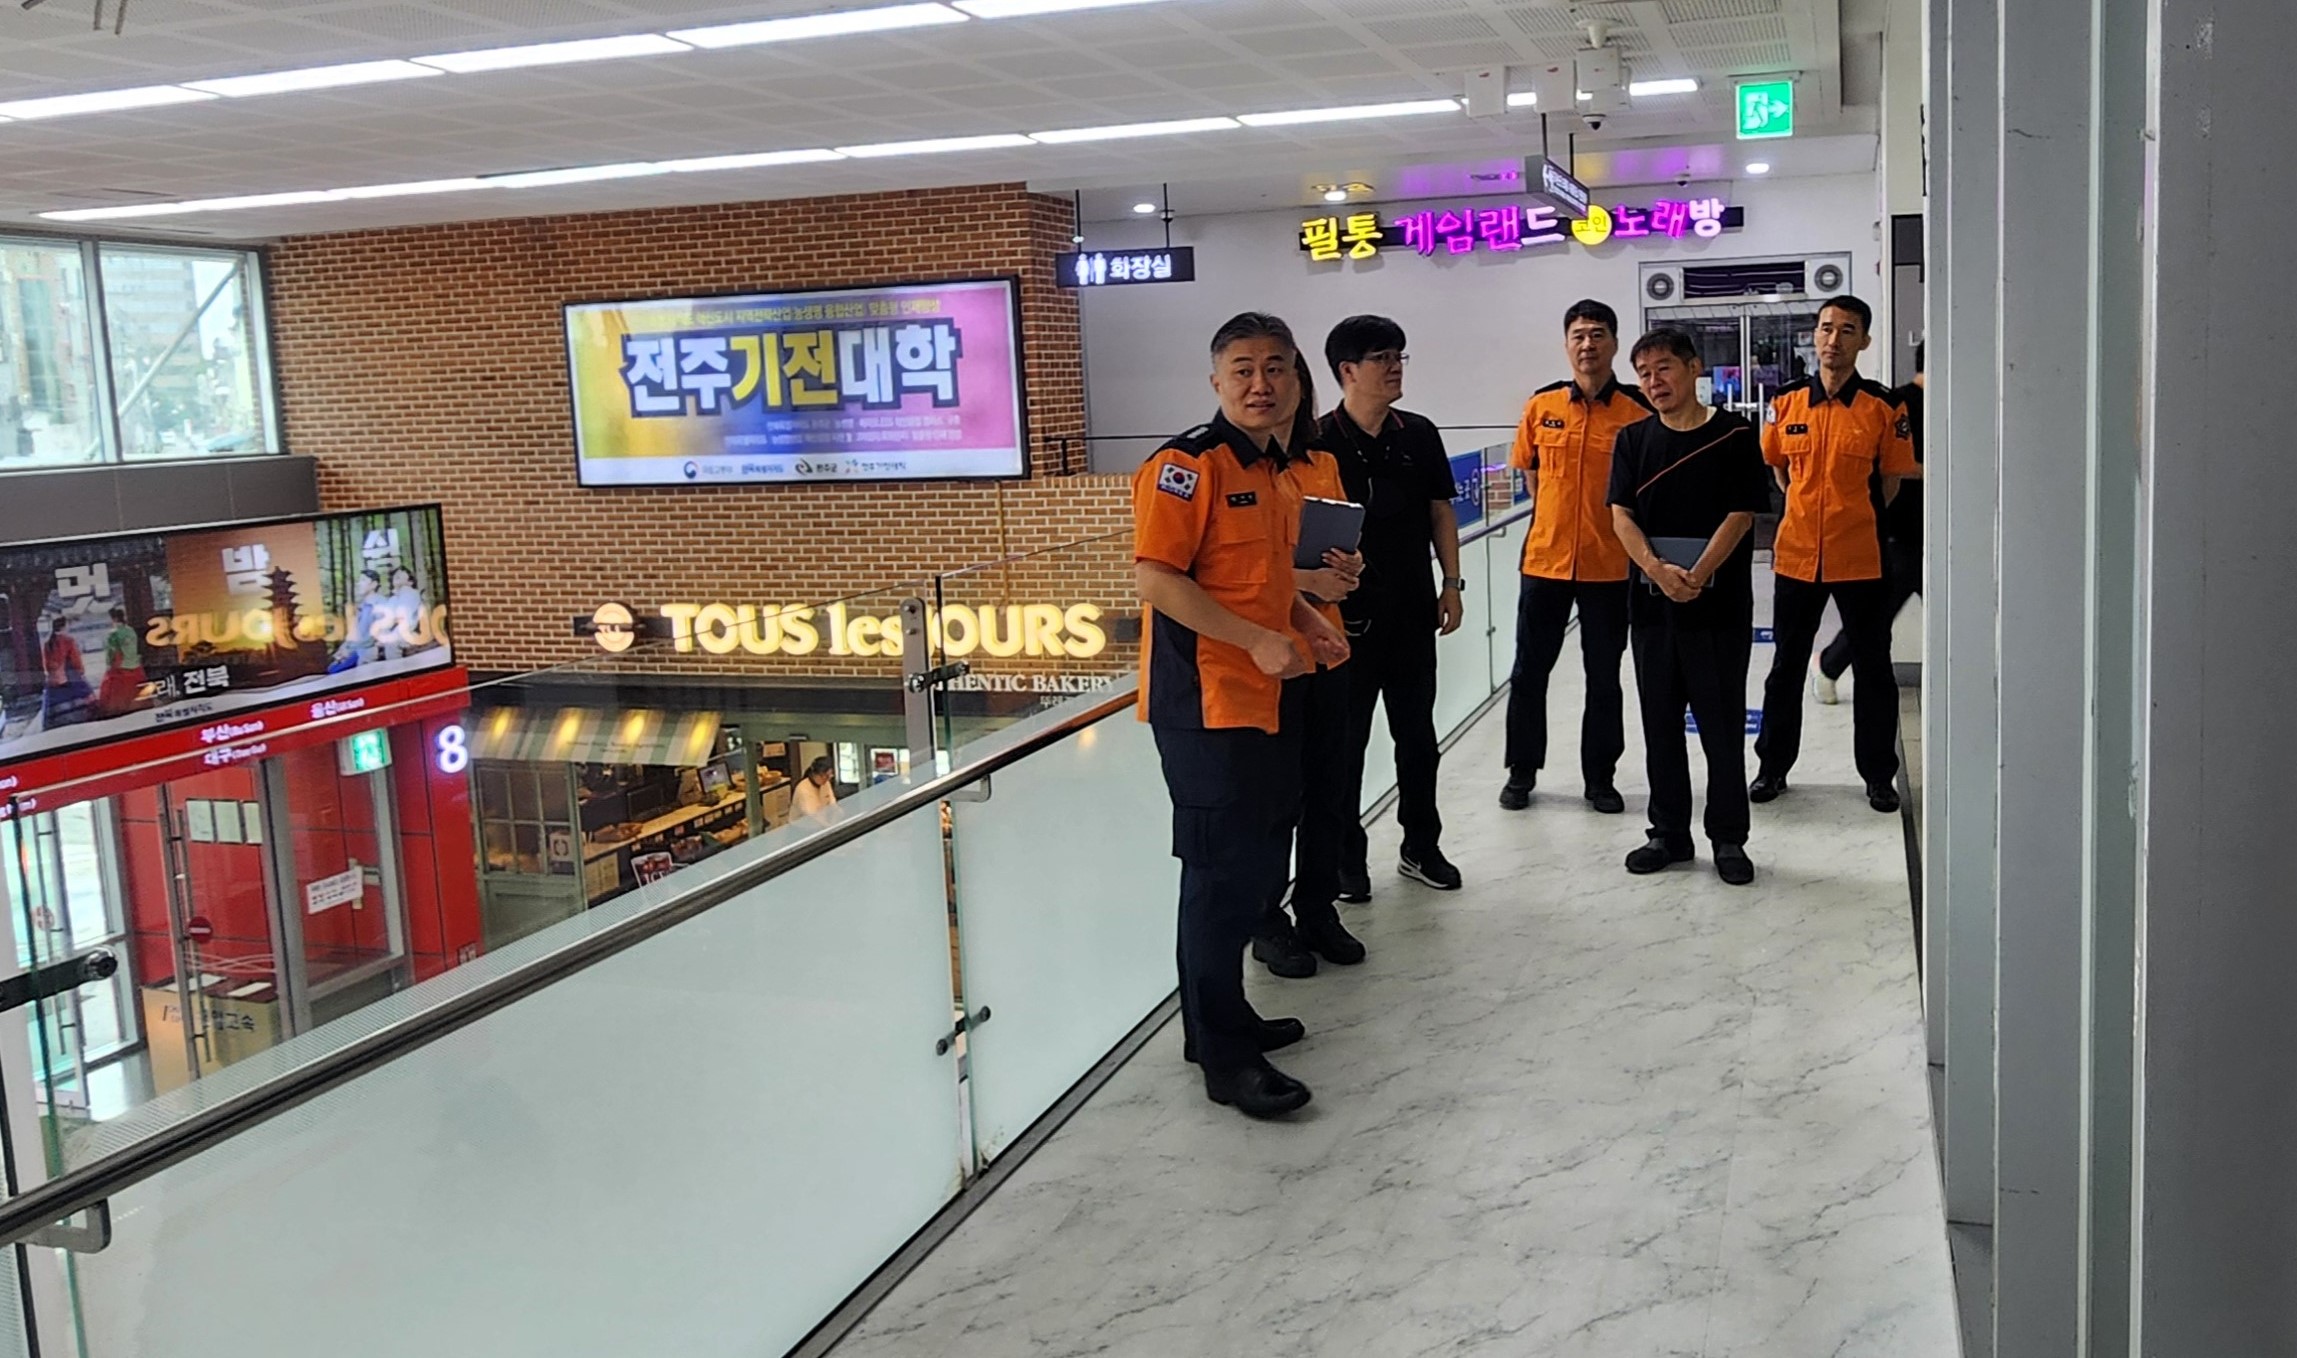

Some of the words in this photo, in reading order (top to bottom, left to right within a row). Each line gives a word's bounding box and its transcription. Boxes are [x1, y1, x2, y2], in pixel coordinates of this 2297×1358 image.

[1301, 212, 1383, 261] 필통
[1395, 205, 1565, 257] 게임랜드
[1614, 198, 1725, 239] 노래방
[1109, 254, 1172, 280] 화장실
[626, 323, 957, 413] 전주기전대학
[55, 563, 114, 617] 멋
[221, 544, 271, 597] 밤
[660, 603, 819, 656] TOUS
[826, 600, 904, 657] les
[183, 665, 230, 695] 전북
[934, 674, 1026, 692] HENTIC
[1032, 674, 1115, 692] BAKERY
[437, 725, 469, 774] 8
